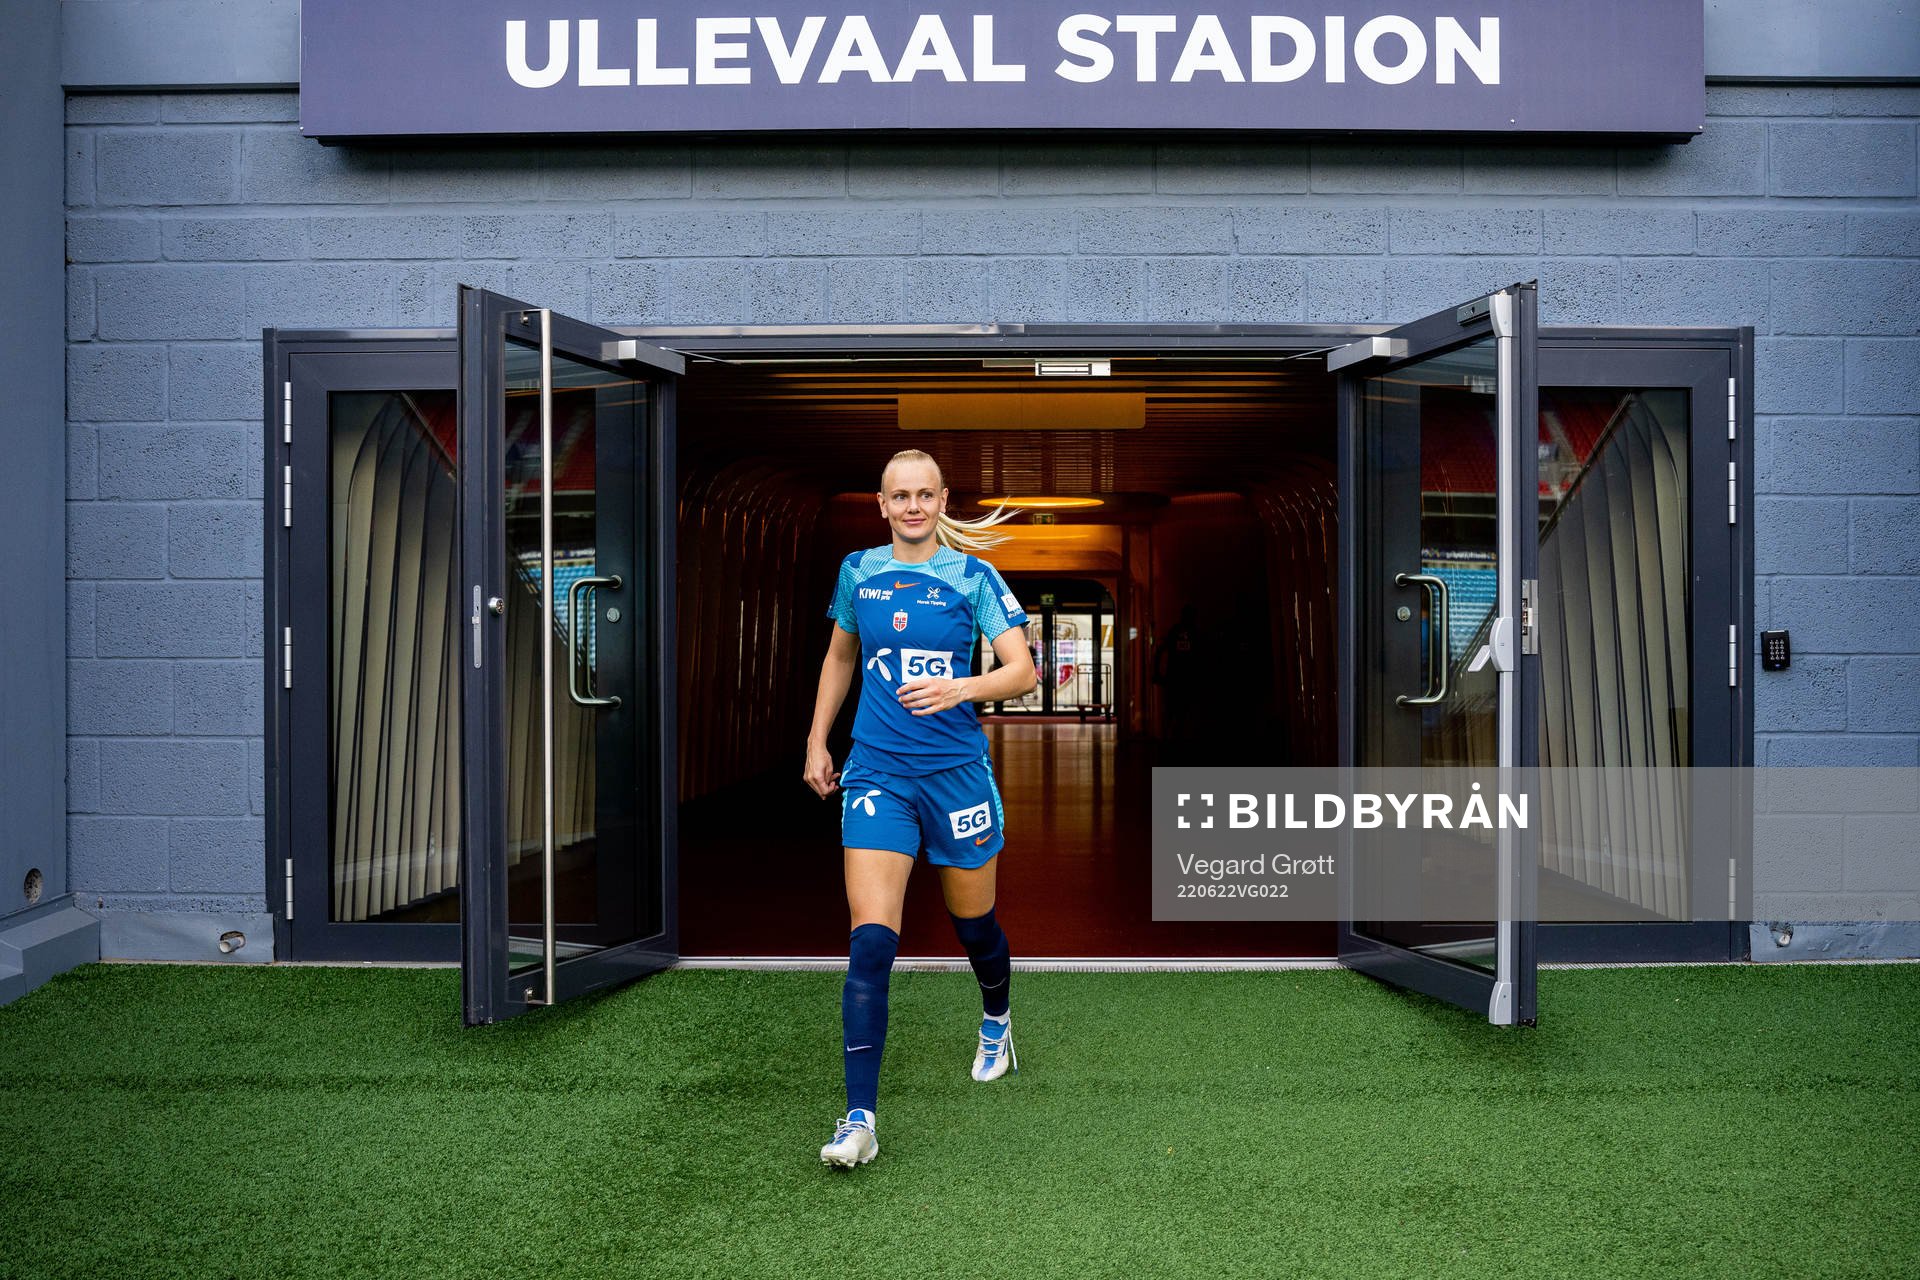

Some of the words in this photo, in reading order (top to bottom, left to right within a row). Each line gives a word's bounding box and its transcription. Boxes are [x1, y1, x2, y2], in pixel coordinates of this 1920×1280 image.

[505, 14, 1026, 89] ULLEVAAL
[1054, 13, 1501, 85] STADION
[859, 587, 881, 599] KIWI
[907, 656, 947, 676] 5G
[957, 809, 987, 833] 5G
